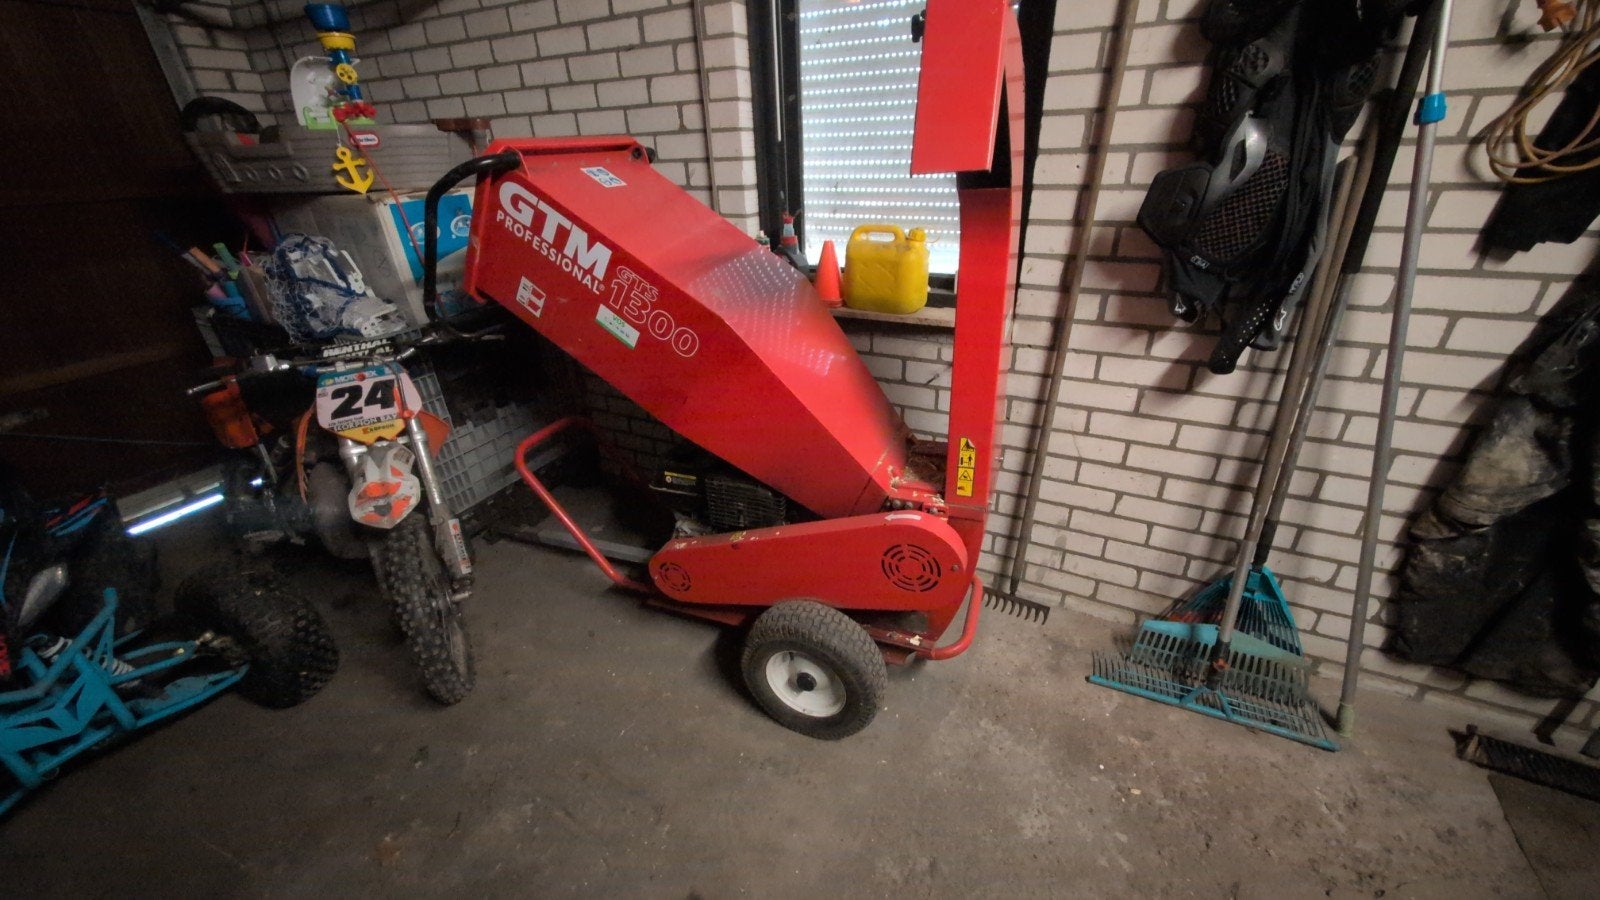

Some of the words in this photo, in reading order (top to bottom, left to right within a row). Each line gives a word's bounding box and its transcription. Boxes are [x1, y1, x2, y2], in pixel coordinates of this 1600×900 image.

[499, 181, 612, 281] GTM
[616, 265, 660, 302] GTS
[609, 280, 700, 358] 1300
[323, 338, 391, 358] RENTHAL
[330, 379, 395, 420] 24
